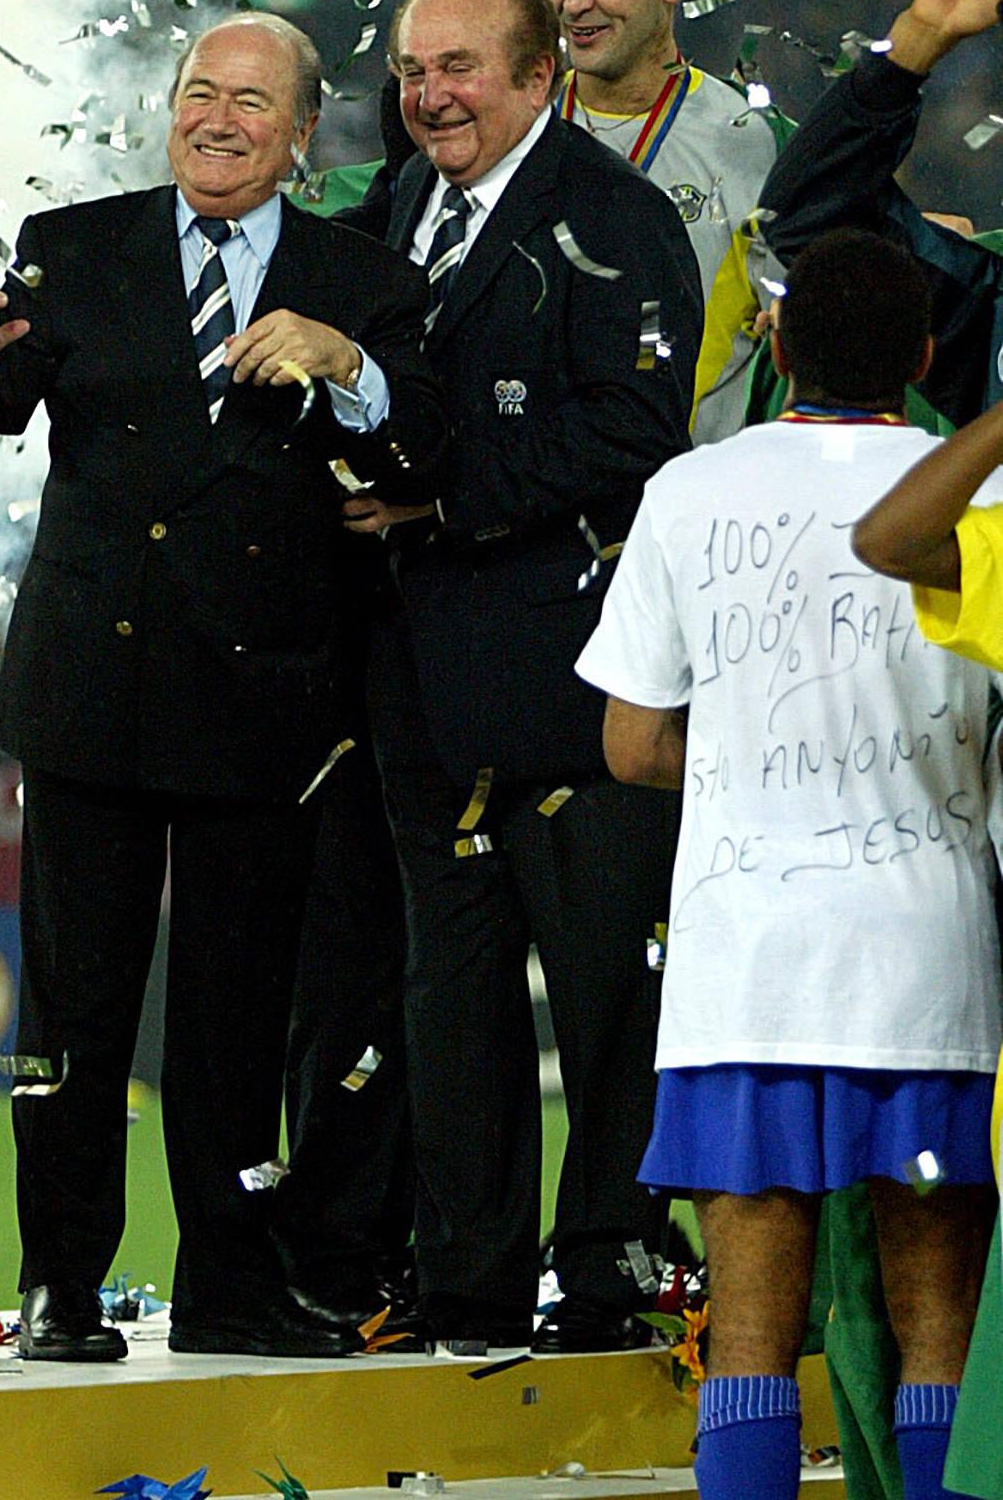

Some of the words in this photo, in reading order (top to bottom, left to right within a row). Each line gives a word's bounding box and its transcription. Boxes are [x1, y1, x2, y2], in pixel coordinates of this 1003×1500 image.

[498, 403, 524, 416] FIFA
[698, 596, 808, 697] 100%
[781, 791, 973, 882] JESUS
